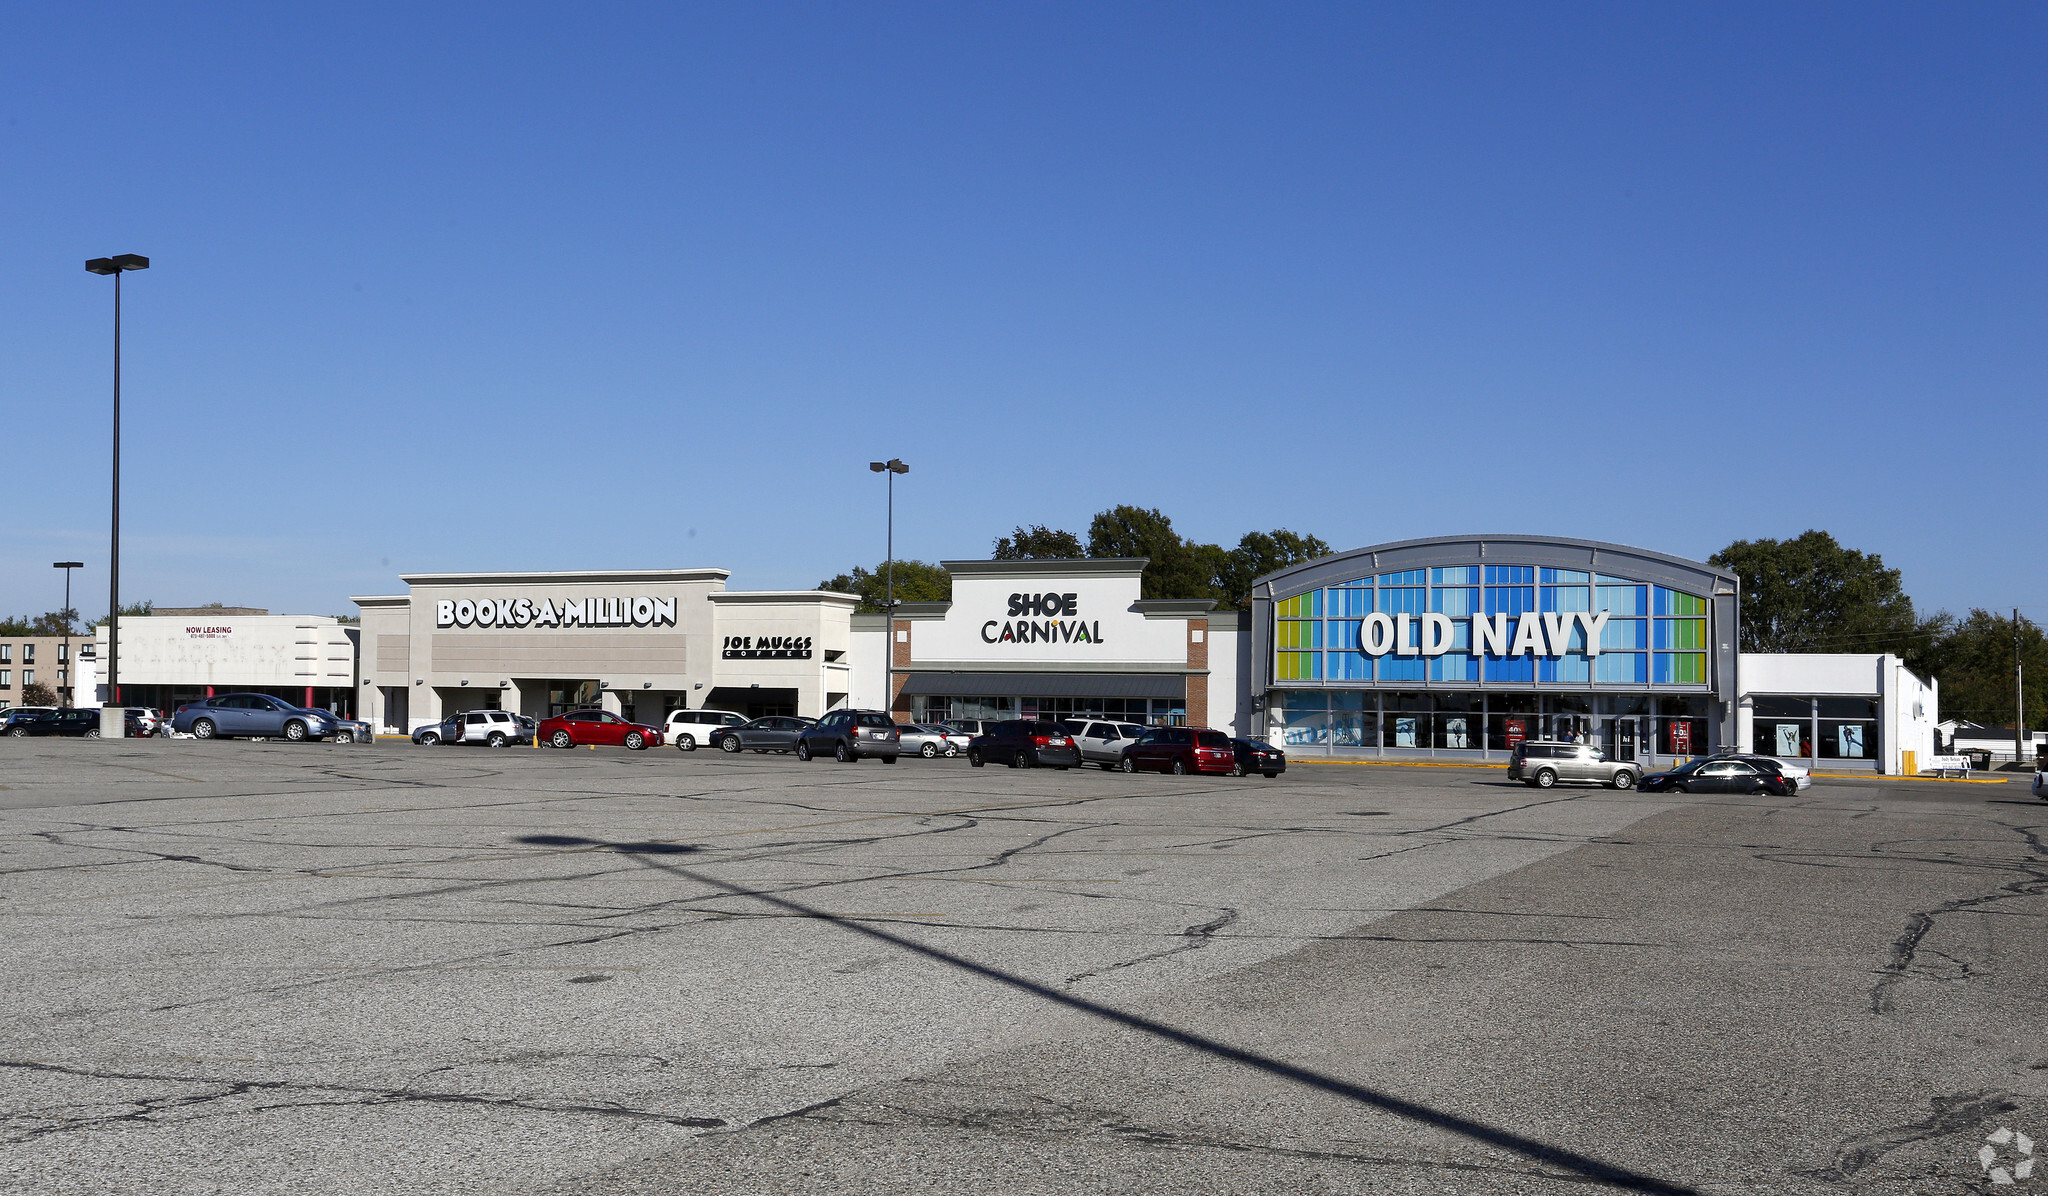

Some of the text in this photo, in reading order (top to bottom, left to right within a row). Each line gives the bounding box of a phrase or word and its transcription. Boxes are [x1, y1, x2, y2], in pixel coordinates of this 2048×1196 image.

[1007, 592, 1078, 617] SHOE
[722, 636, 812, 650] JOE MUGGS
[1360, 611, 1612, 656] OLD NAVY
